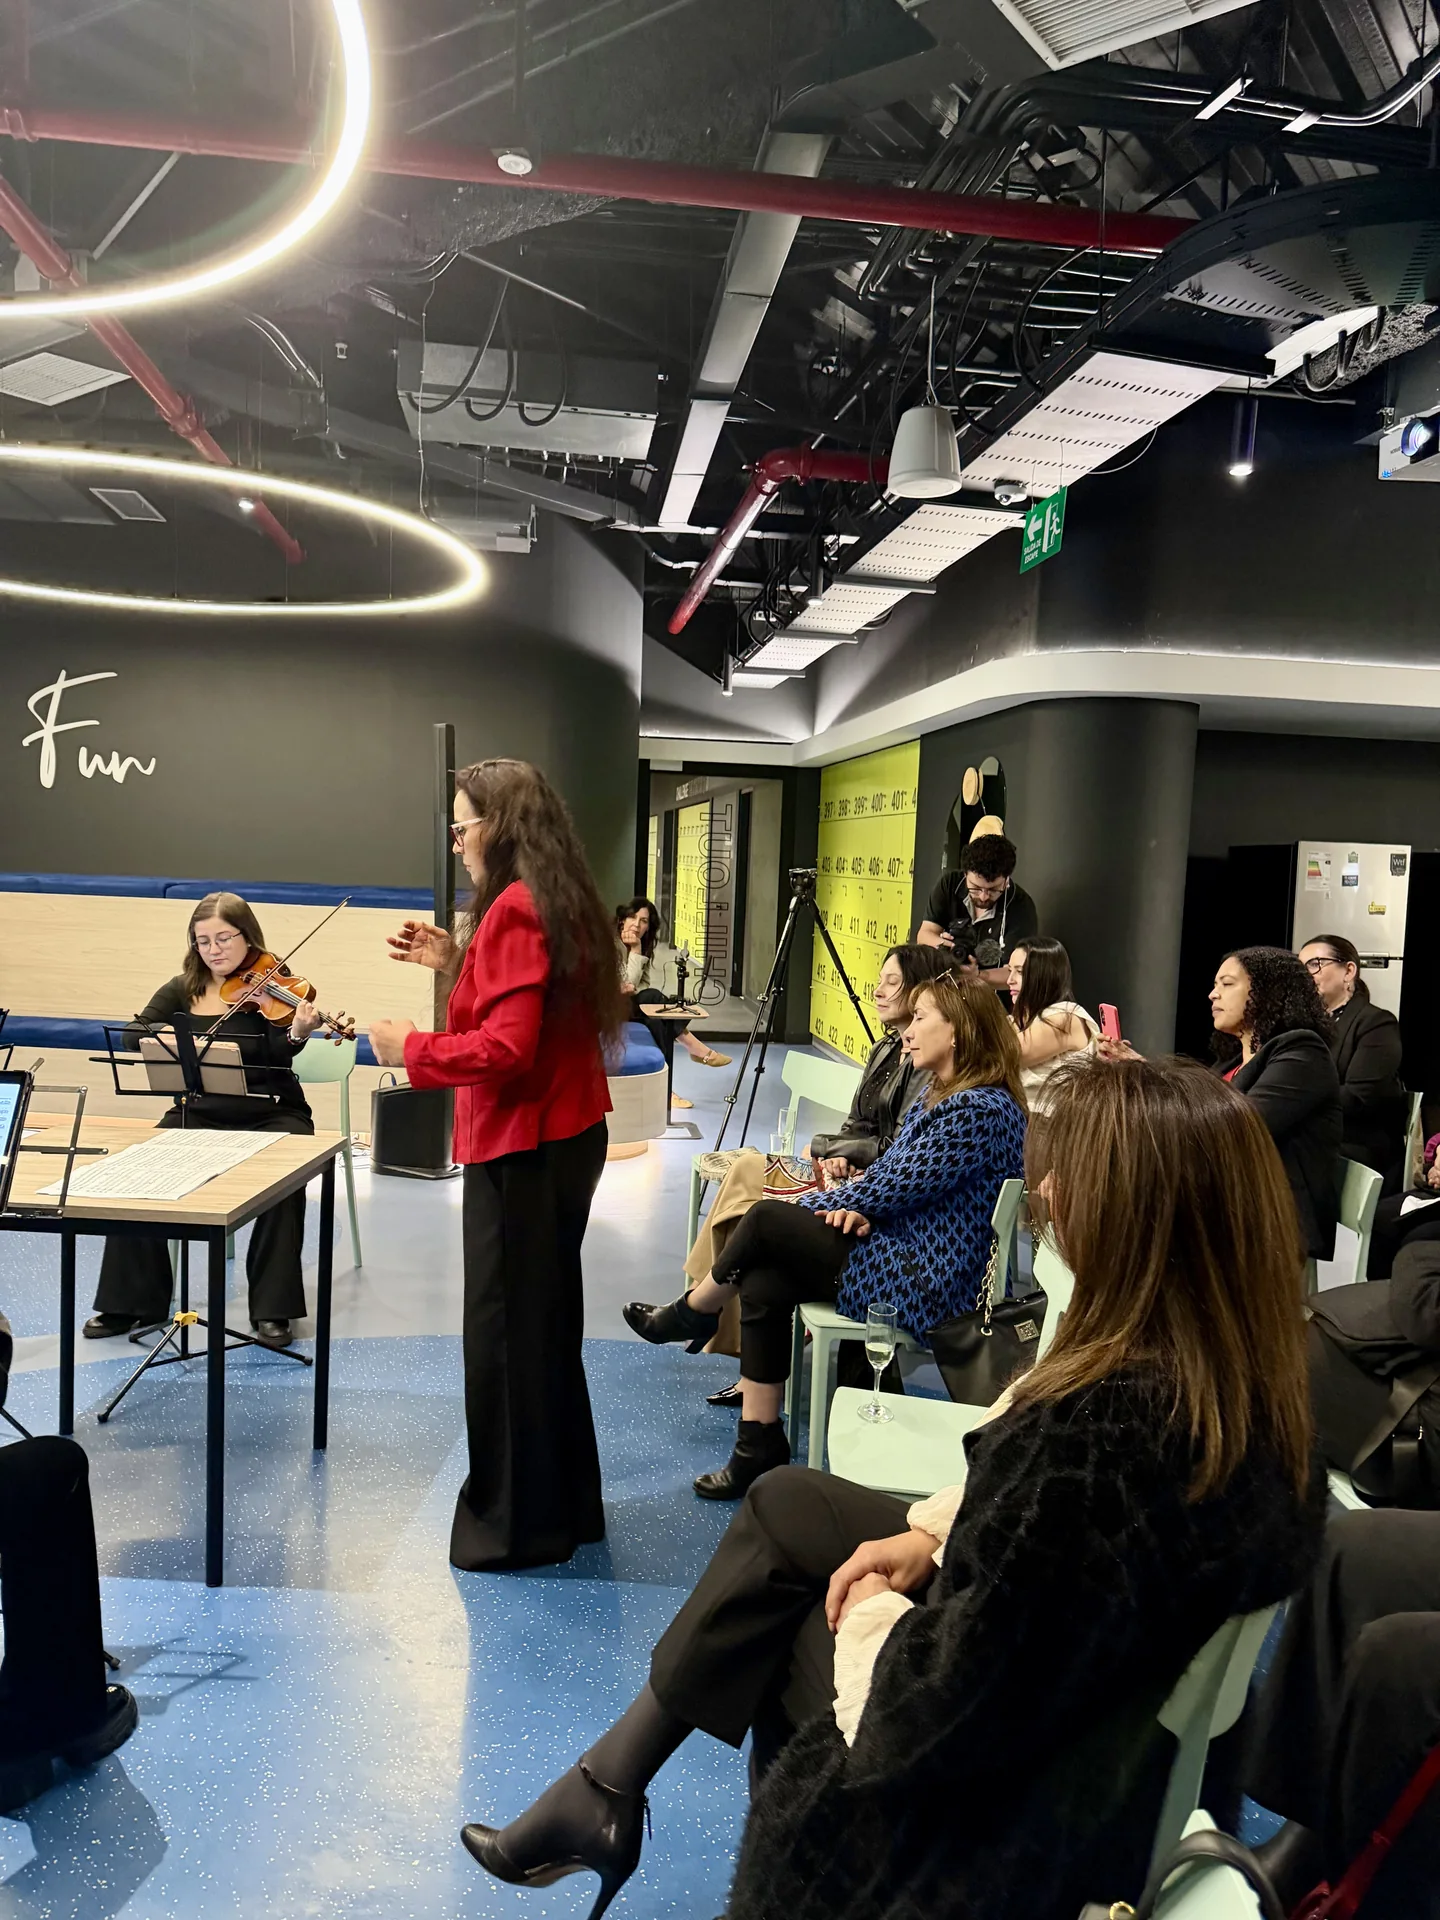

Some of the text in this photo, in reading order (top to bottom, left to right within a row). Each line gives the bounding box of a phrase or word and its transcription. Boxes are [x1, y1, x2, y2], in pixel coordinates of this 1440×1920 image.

[22, 669, 156, 788] Fun
[824, 801, 833, 819] 397
[853, 796, 865, 815] 399
[871, 792, 884, 812] 400
[891, 790, 905, 811] 401
[821, 856, 831, 873] 403
[835, 857, 845, 874] 404
[851, 857, 862, 875] 405
[869, 857, 880, 876] 406
[887, 857, 900, 878] 407
[833, 912, 843, 931] 410
[849, 916, 860, 935] 411
[866, 918, 877, 939] 412
[884, 923, 898, 945] 413
[817, 963, 875, 1002] 415 416 17 418
[815, 1017, 870, 1064] 421 422 423 42
